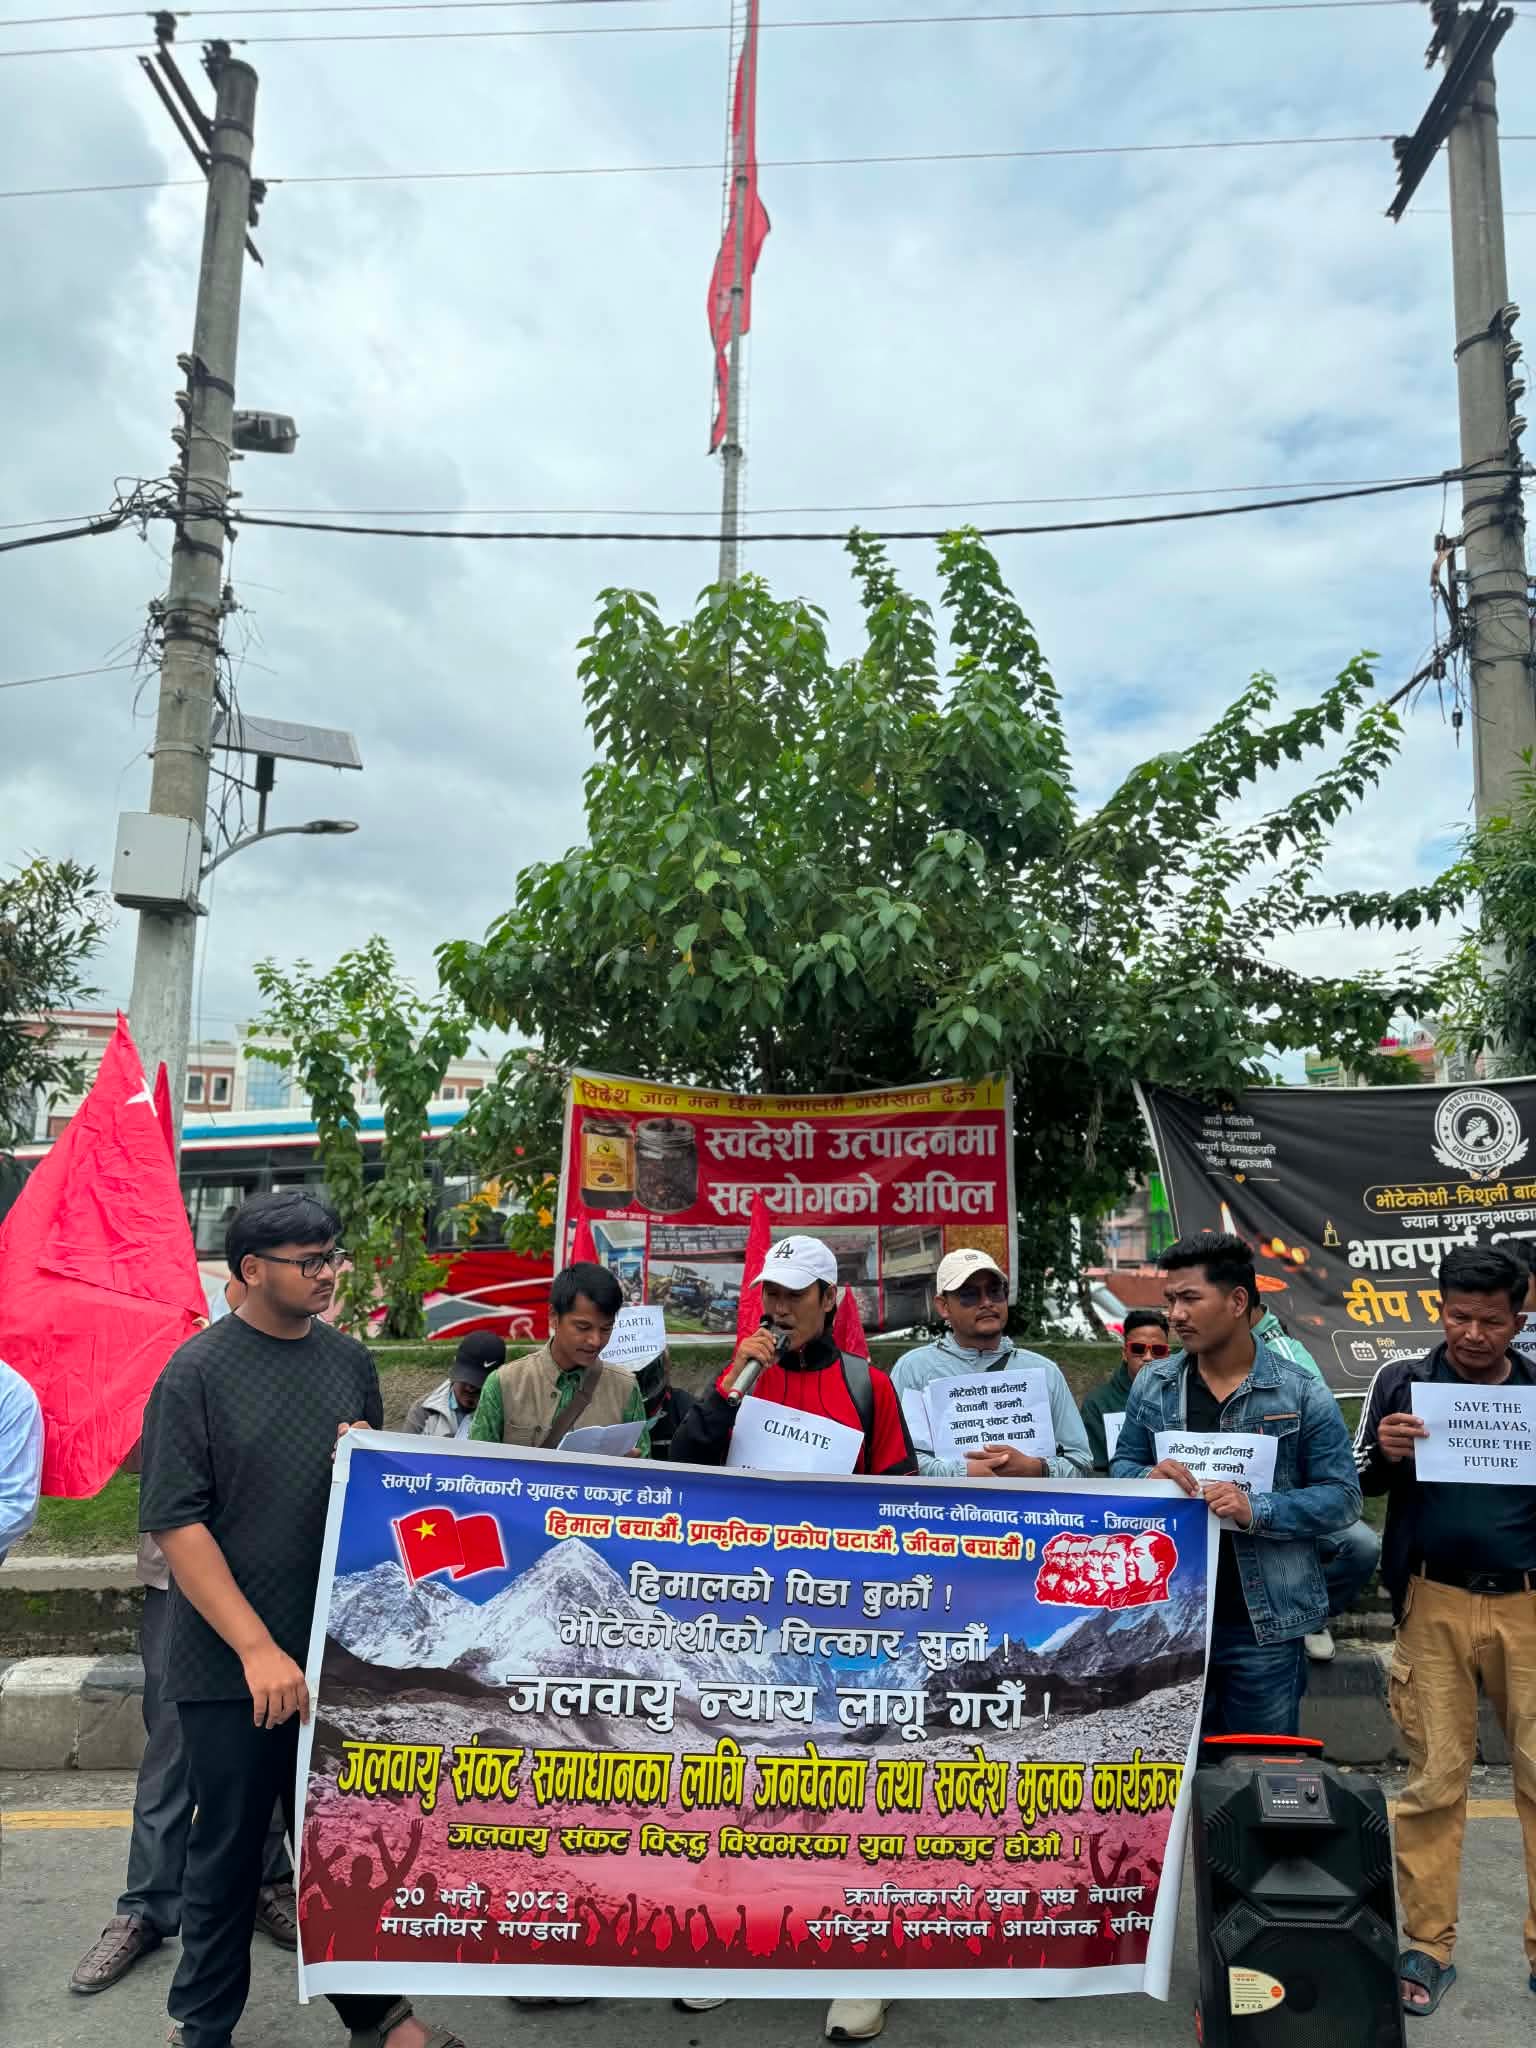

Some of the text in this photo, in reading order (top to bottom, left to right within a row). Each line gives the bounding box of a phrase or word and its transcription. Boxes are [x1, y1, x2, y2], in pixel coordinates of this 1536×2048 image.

[704, 1120, 998, 1161] स्वदेशी उत्पादनमा
[1477, 1154, 1492, 1164] WE
[1492, 1141, 1511, 1159] RISE
[892, 1170, 997, 1214] अपिल
[1401, 1214, 1438, 1229] ज्यान
[1343, 1278, 1412, 1327] दीप
[618, 1317, 654, 1329] EARTH,
[618, 1334, 637, 1344] ONE
[1454, 1401, 1522, 1414] SAVE THE
[763, 1419, 832, 1450] CLIMATE
[950, 1419, 985, 1430] जलवायु
[1448, 1419, 1531, 1433] HIMALAYAS,
[1448, 1437, 1532, 1451] SECURE THE
[1464, 1456, 1519, 1468] FUTURE
[380, 1473, 432, 1495] सम्पूर्ण
[435, 1475, 523, 1498] क्रान्तिकारी
[584, 1485, 634, 1506] एकजुट
[547, 1509, 611, 1537] हिमाल
[689, 1519, 769, 1548] प्राकृतिक
[775, 1524, 829, 1548] प्रकोप
[905, 1531, 956, 1554] जीवन
[963, 1533, 1021, 1559] बचाऔं
[629, 1560, 954, 1617] हिमालको पिडा बुझौं !
[559, 1606, 1010, 1670] भोटेकोशीको चित्कार सुनौं !
[506, 1674, 1051, 1742] जलवायु न्याय लागू गरौं !
[337, 1740, 444, 1811] जलवायु
[452, 1734, 525, 1802] संकट
[532, 1749, 673, 1805] समाधानका
[680, 1736, 747, 1808] लागि
[754, 1741, 869, 1810] जनचेतना
[877, 1760, 928, 1811] तथा
[934, 1744, 1010, 1814] सन्देश
[1016, 1762, 1085, 1826] मुलक
[447, 1821, 551, 1854] जलवायु
[560, 1823, 632, 1852] संकट
[719, 1825, 850, 1855] विश्वभरका
[858, 1834, 906, 1861] युवा
[916, 1835, 996, 1862] एकजुट
[394, 1882, 569, 1913] २० भदौ, २०८३
[845, 1882, 1146, 1912] क्रान्तिकारी युवा संघ नेपाल
[380, 1912, 582, 1942] माइतीघर मण्डला
[807, 1910, 1154, 1944] राष्ट्रिय सम्मेलन आयोजक समि
